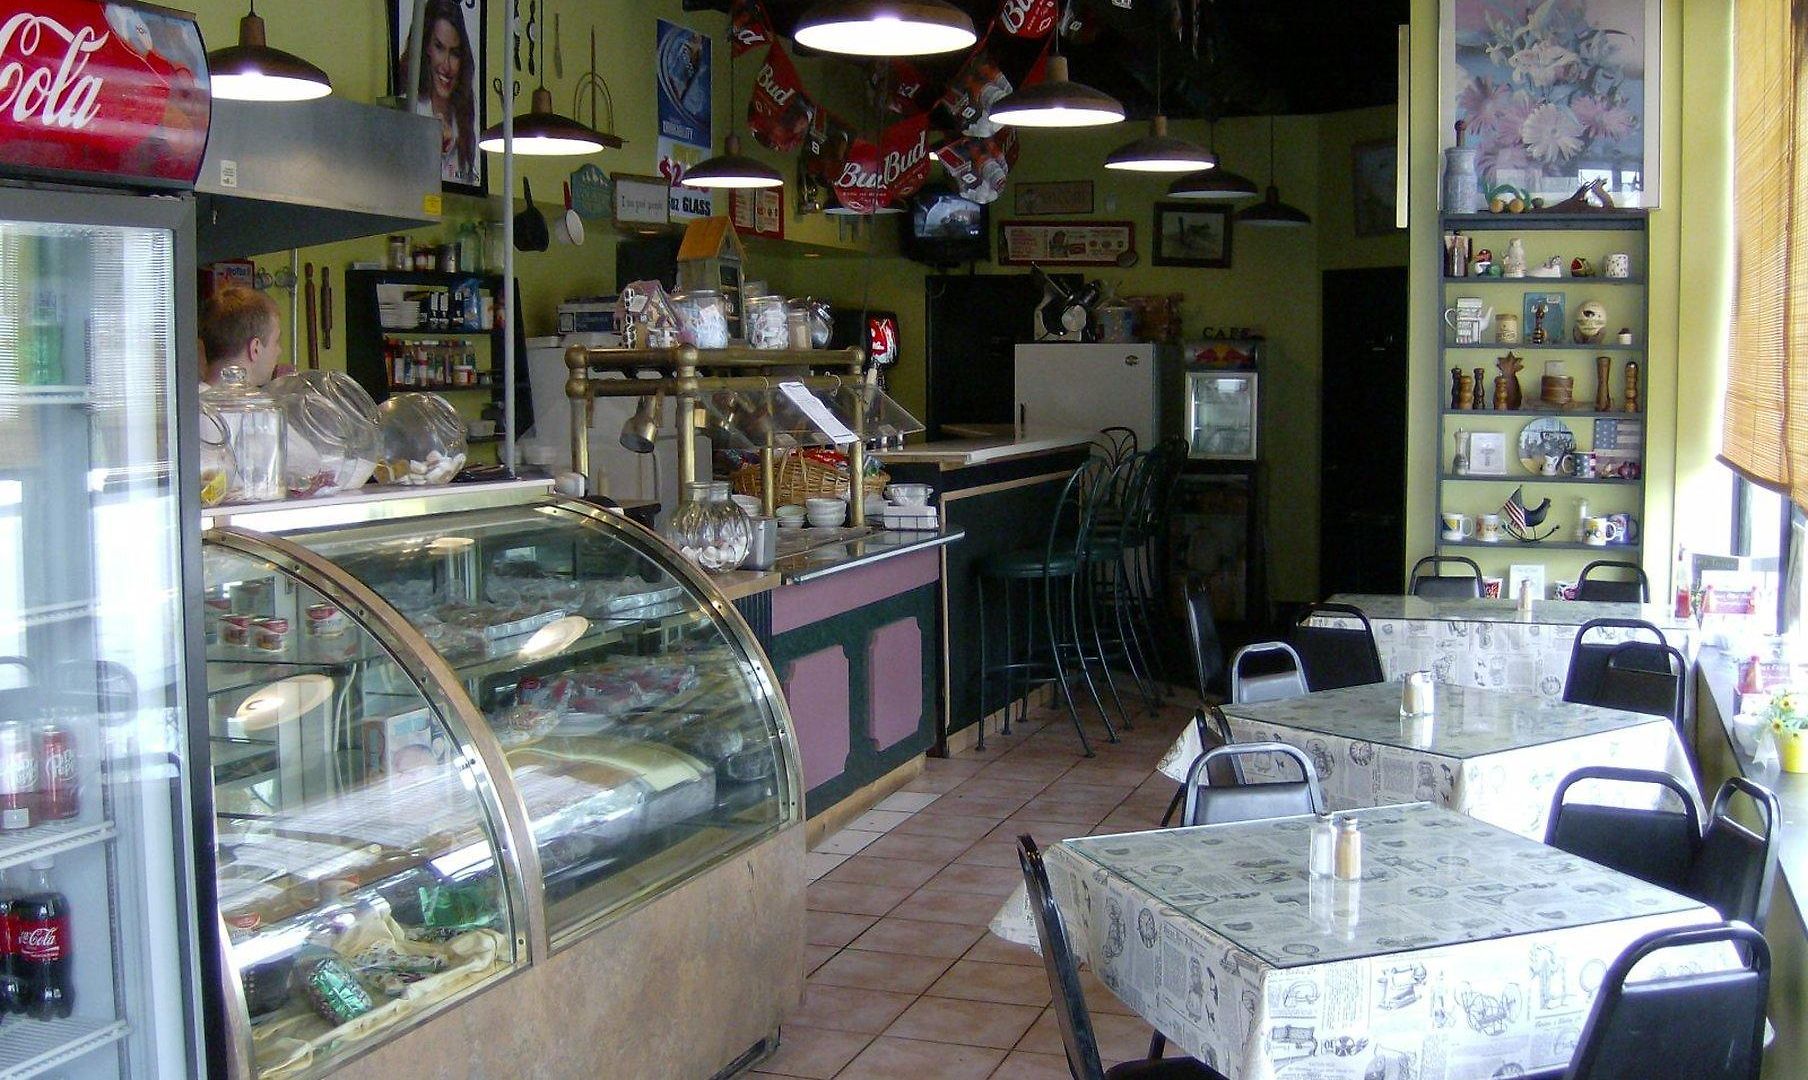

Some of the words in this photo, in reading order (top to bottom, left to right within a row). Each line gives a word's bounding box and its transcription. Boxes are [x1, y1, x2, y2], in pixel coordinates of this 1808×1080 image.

[757, 63, 796, 106] Bud
[884, 130, 926, 184] Bud
[682, 196, 711, 217] GLASS
